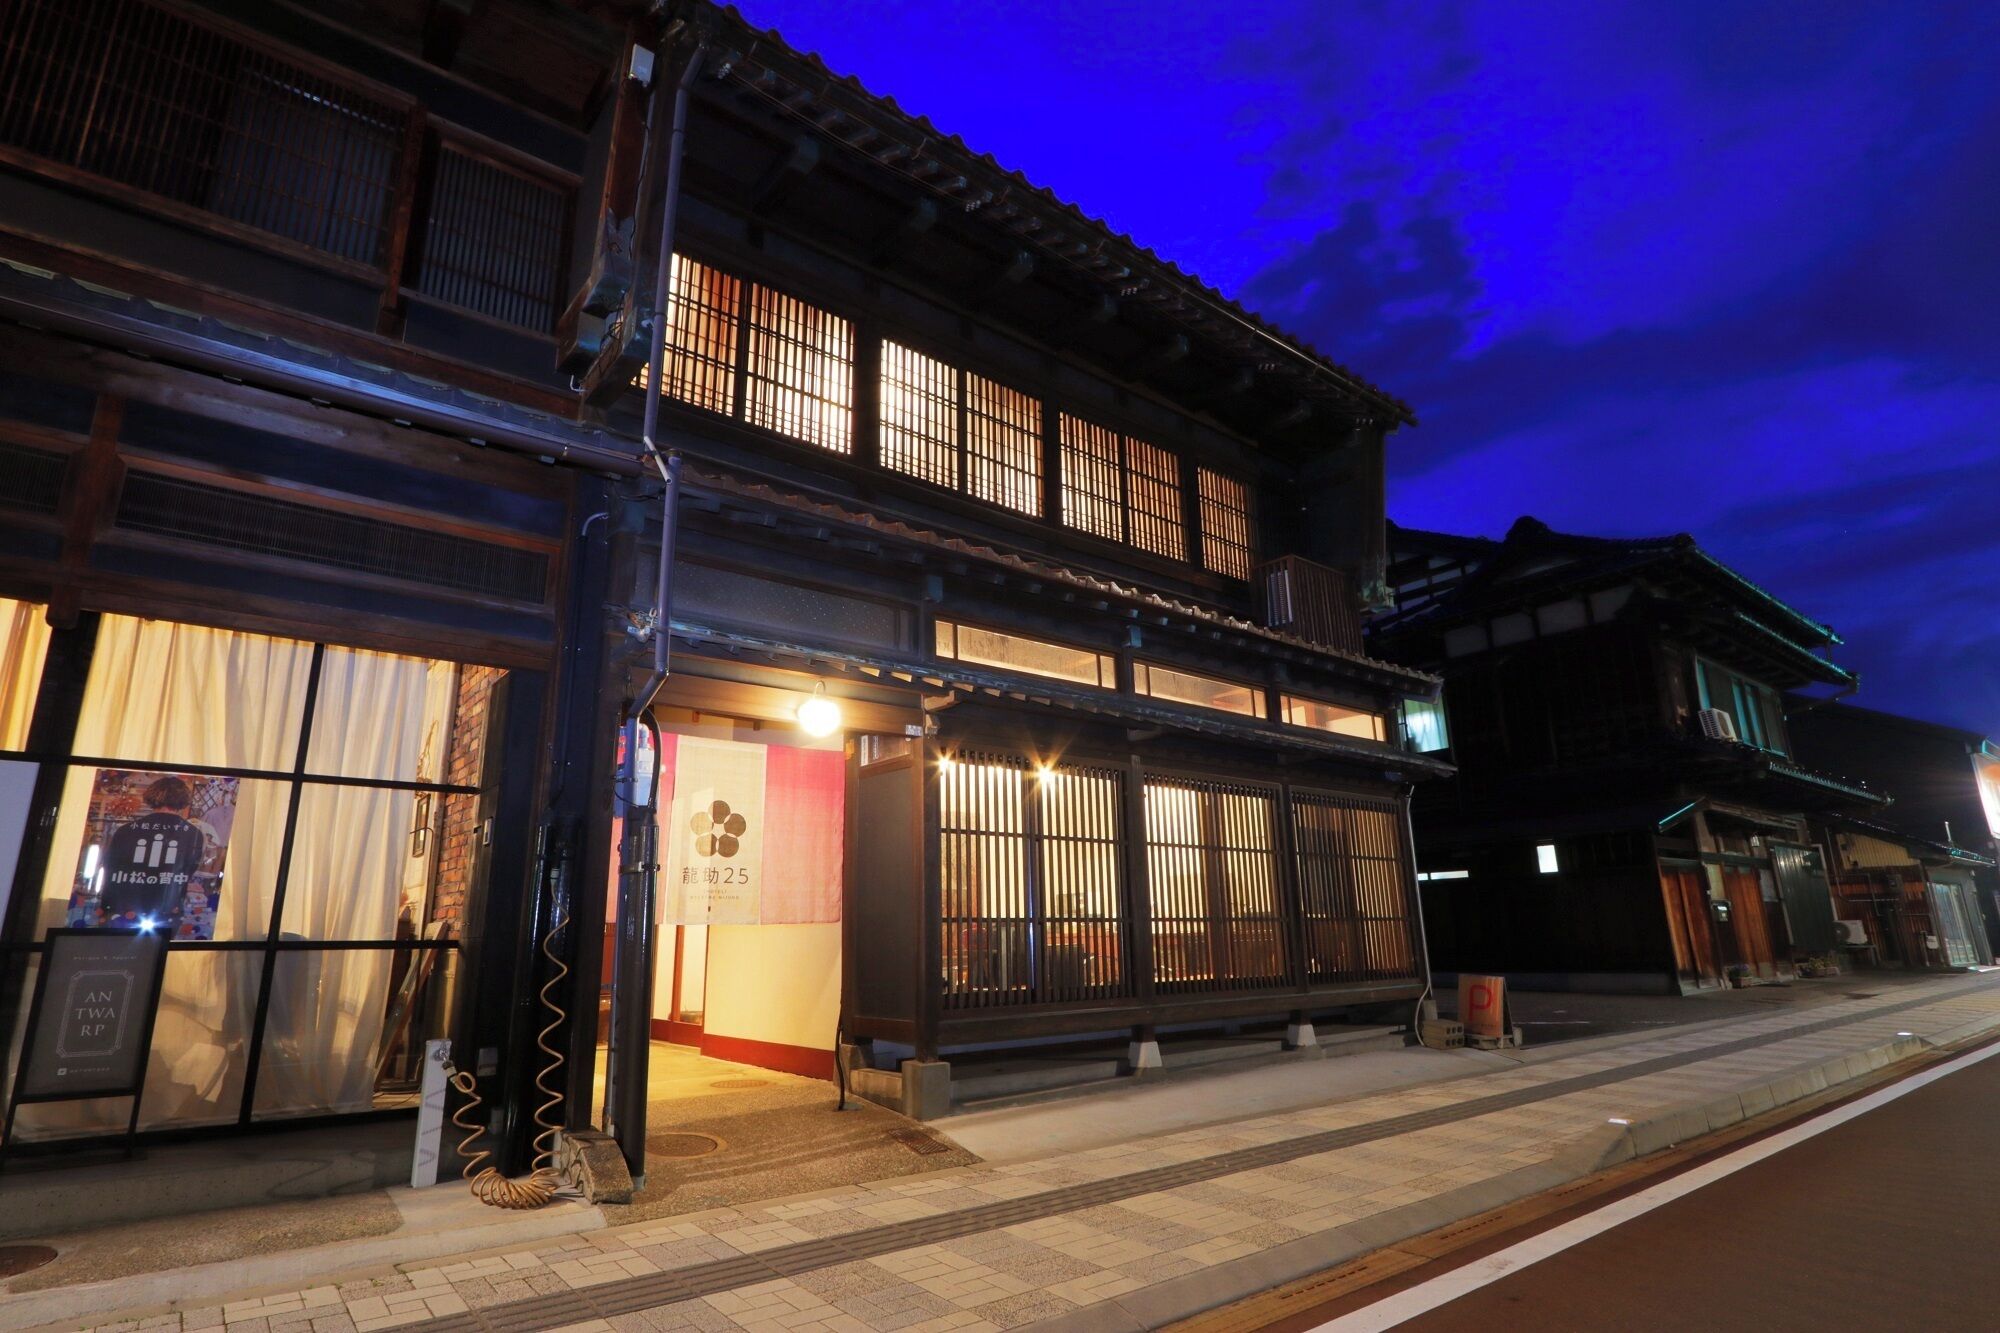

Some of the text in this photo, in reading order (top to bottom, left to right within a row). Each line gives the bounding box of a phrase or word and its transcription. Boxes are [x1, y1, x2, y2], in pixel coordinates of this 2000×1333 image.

[129, 822, 190, 832] 小松だいすき
[111, 870, 189, 885] 小松の背中
[682, 866, 749, 885] 龍助25
[84, 991, 113, 1002] AN
[1468, 984, 1492, 1021] P
[74, 1007, 116, 1020] TWA
[80, 1024, 105, 1036] RP
